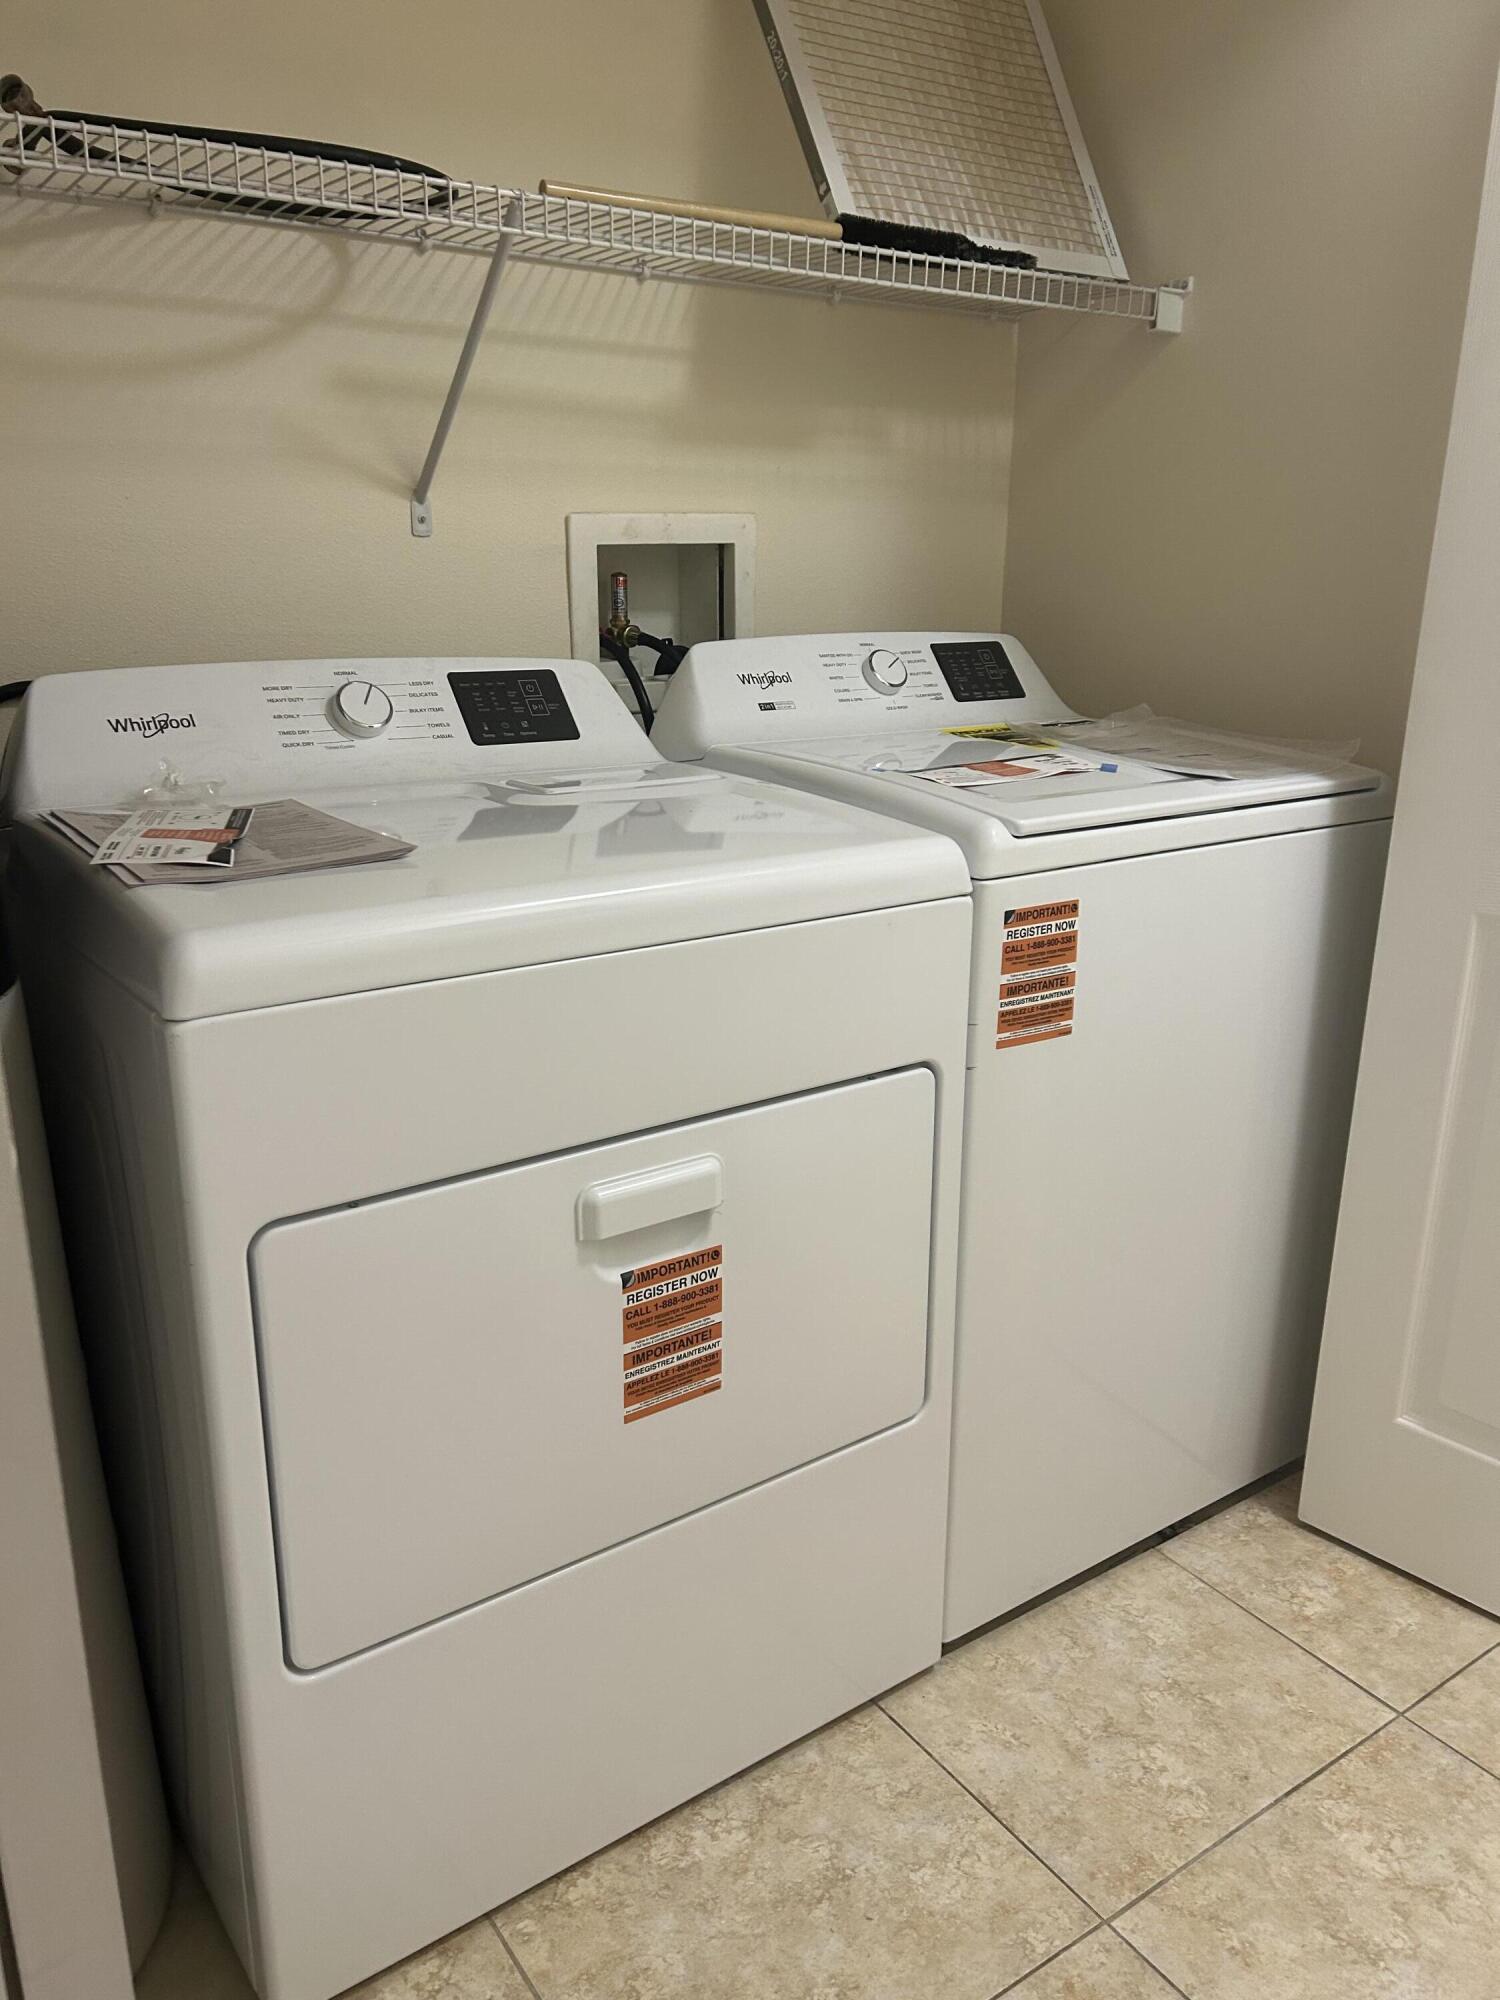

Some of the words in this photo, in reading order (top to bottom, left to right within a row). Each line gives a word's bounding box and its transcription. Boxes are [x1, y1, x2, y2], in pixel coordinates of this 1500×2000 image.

[736, 671, 792, 690] Whirlpool
[106, 713, 196, 738] Whirlpool
[1016, 904, 1071, 923] IMPORTANT!
[1007, 923, 1053, 940] REGISTER
[1054, 919, 1077, 932] NOW
[1004, 943, 1025, 954] CALL
[1006, 976, 1069, 997] IMPORTANTE!
[1000, 995, 1039, 1009] ENREGISTREZ
[1039, 988, 1075, 1000] MAINTENANT
[636, 1251, 710, 1284] IMPORTANT!
[626, 1277, 688, 1305] REGISTER
[690, 1266, 719, 1285] NOW
[625, 1305, 652, 1321] CALL
[653, 1283, 719, 1311] 1-888-900-3381
[632, 1328, 712, 1366] IMPORTANTE!
[624, 1356, 675, 1380] ENREGISTREZ
[676, 1340, 721, 1361] MAINTENANT
[626, 1373, 660, 1391] APPELEZ
[660, 1370, 670, 1378] LE
